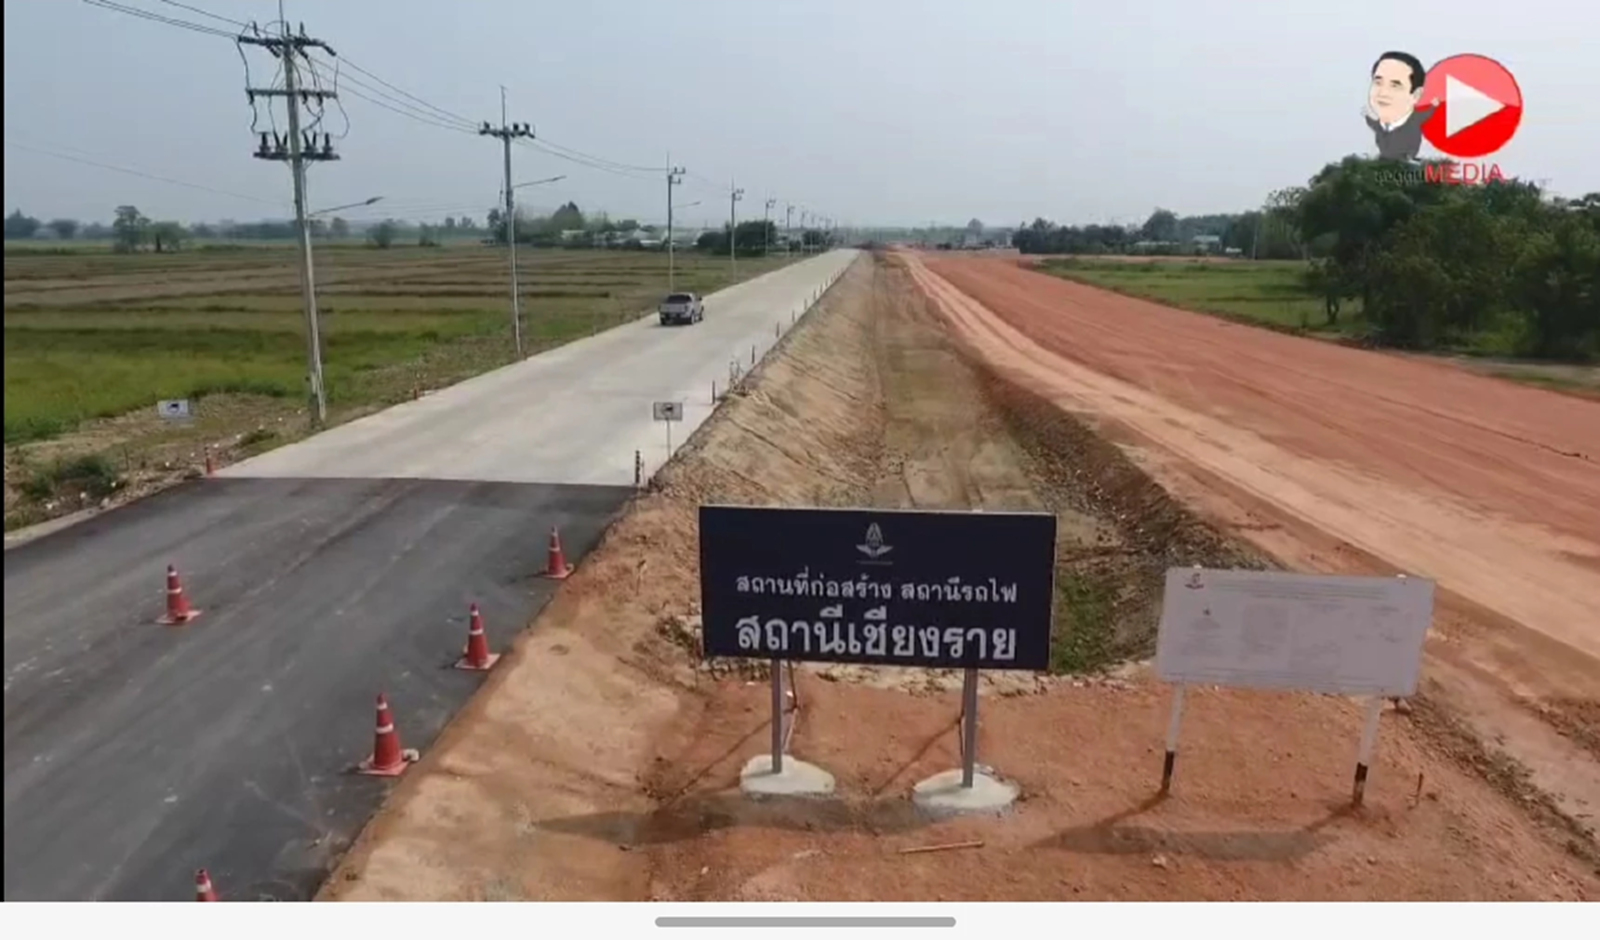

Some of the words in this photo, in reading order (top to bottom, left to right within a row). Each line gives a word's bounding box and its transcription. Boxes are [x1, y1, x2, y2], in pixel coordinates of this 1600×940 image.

[736, 566, 892, 599] สถานที่ก่อสร้าง
[901, 576, 1018, 602] สถานีรถไฟ
[735, 604, 1017, 660] สถานีเชียงราย
